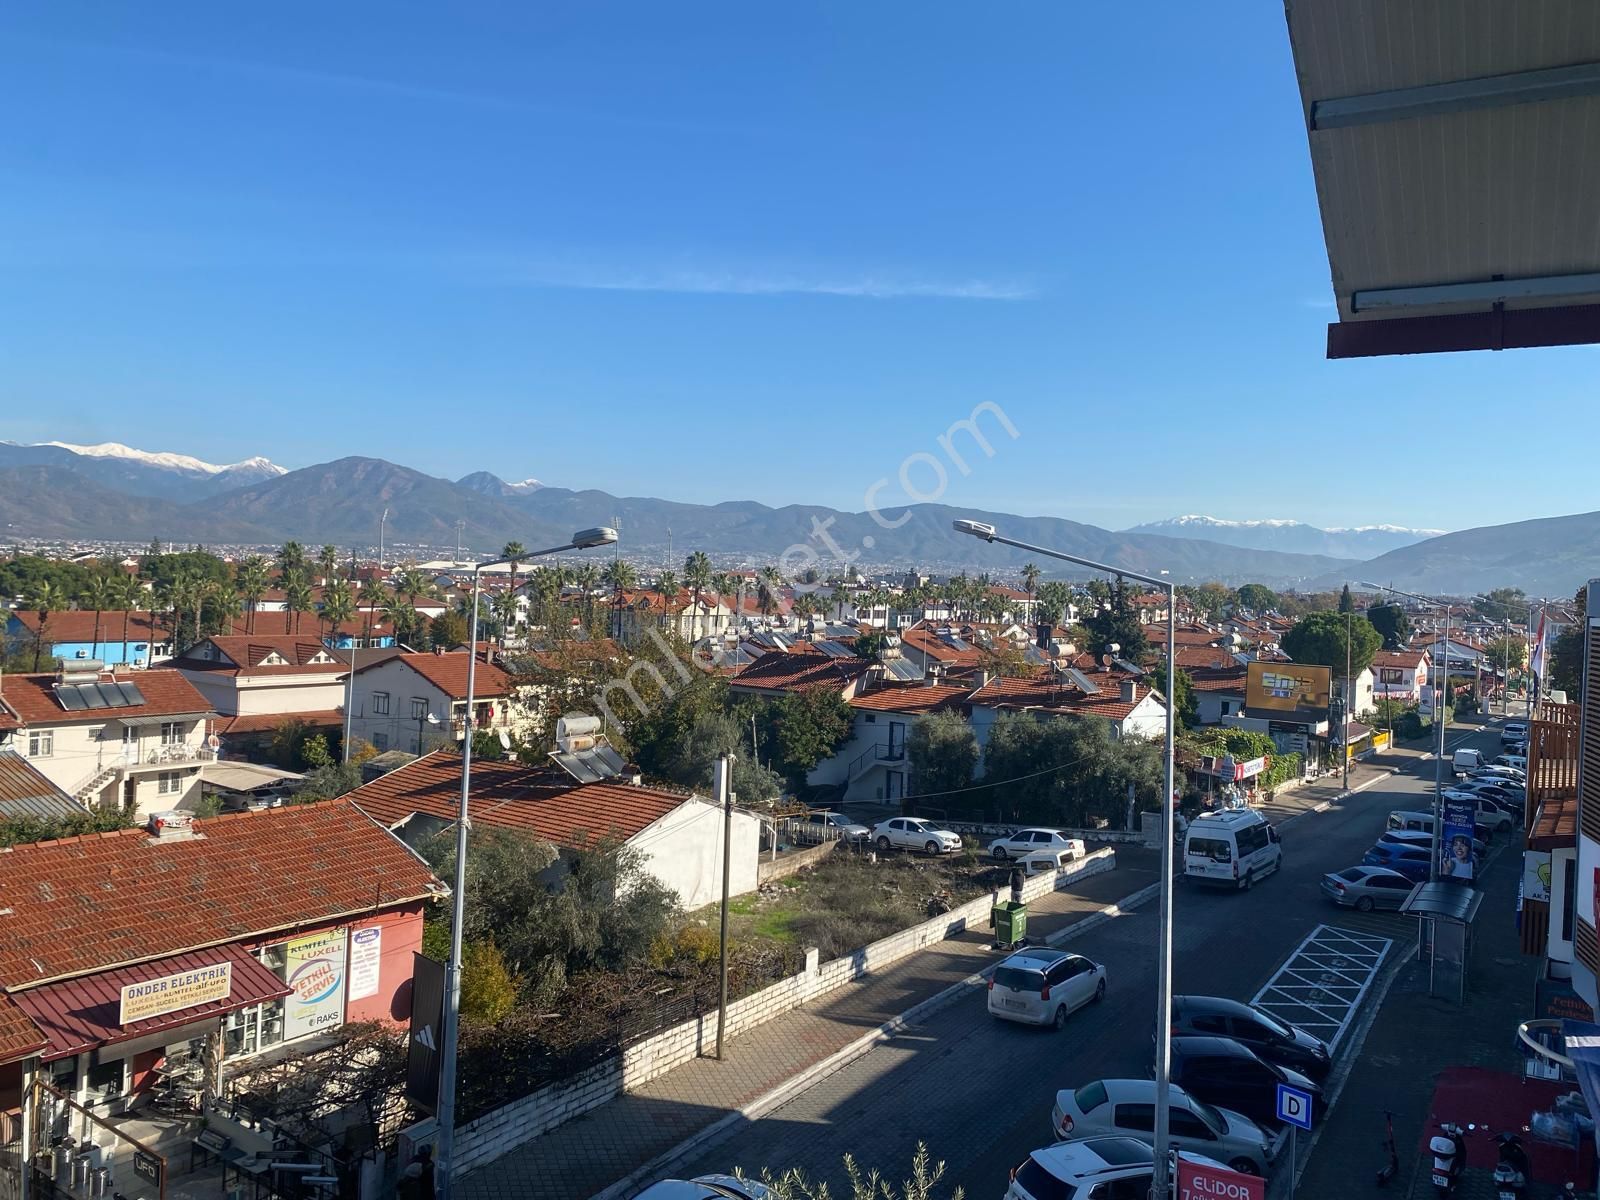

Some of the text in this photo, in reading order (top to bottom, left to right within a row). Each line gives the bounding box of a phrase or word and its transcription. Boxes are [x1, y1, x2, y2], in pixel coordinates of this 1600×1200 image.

[290, 939, 329, 954] KUMTEL
[301, 945, 343, 960] LUXELL
[128, 967, 227, 999] ÖNDER ELEKTRİK
[316, 1011, 339, 1024] RAKS
[1288, 1096, 1300, 1115] D
